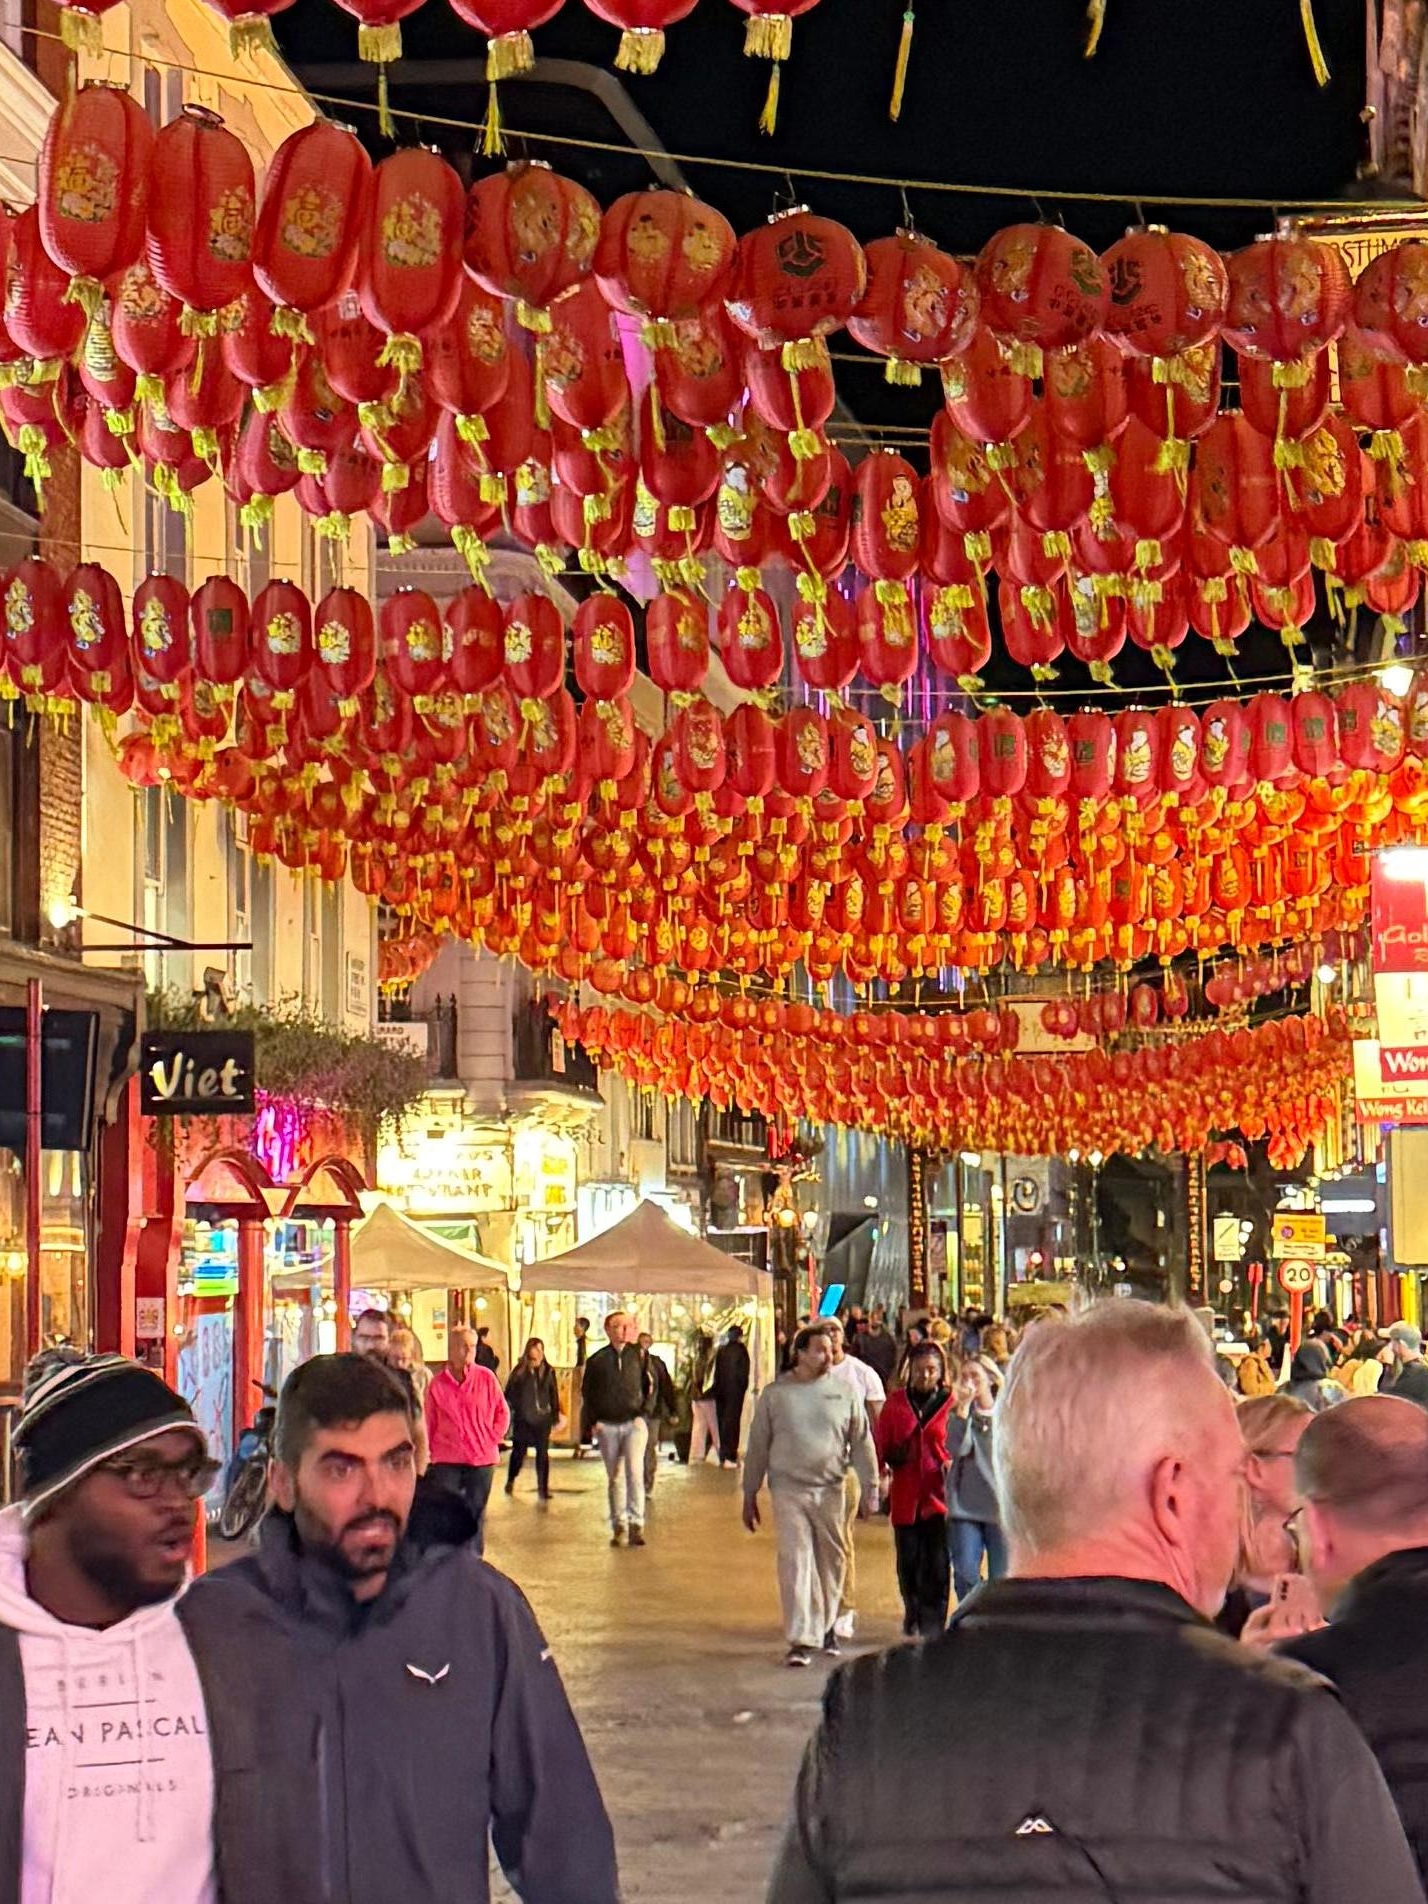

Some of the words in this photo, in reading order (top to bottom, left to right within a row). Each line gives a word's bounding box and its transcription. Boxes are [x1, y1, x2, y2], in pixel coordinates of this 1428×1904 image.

[152, 1051, 239, 1098] Viet
[1359, 1099, 1403, 1120] Wong
[1406, 1098, 1428, 1117] Kei
[1286, 1268, 1311, 1283] 20
[56, 1671, 166, 1692] BERLN
